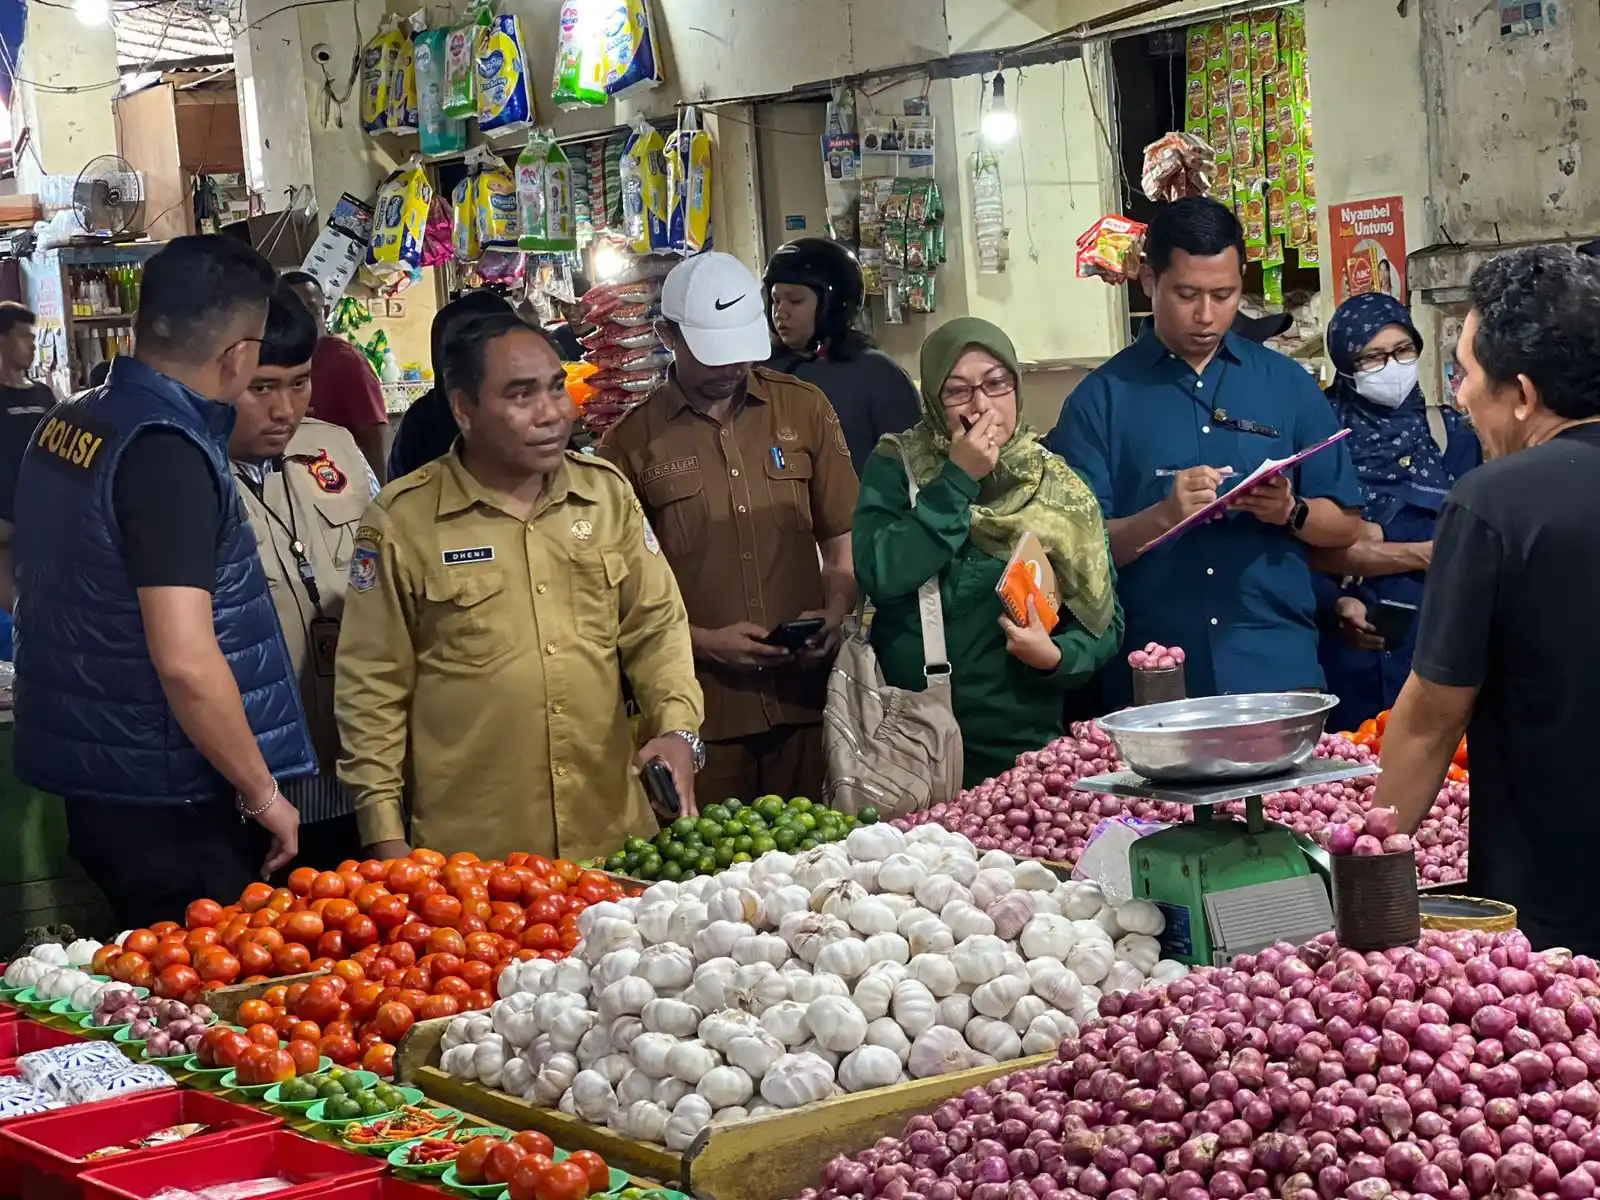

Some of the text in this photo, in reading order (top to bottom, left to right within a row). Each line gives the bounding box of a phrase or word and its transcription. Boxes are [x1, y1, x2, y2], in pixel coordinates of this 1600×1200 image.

[1341, 203, 1390, 225] Nyambel
[1354, 221, 1394, 236] Untung
[1355, 269, 1370, 279] ABC
[37, 416, 104, 469] POLISI
[452, 551, 485, 560] DHENI
